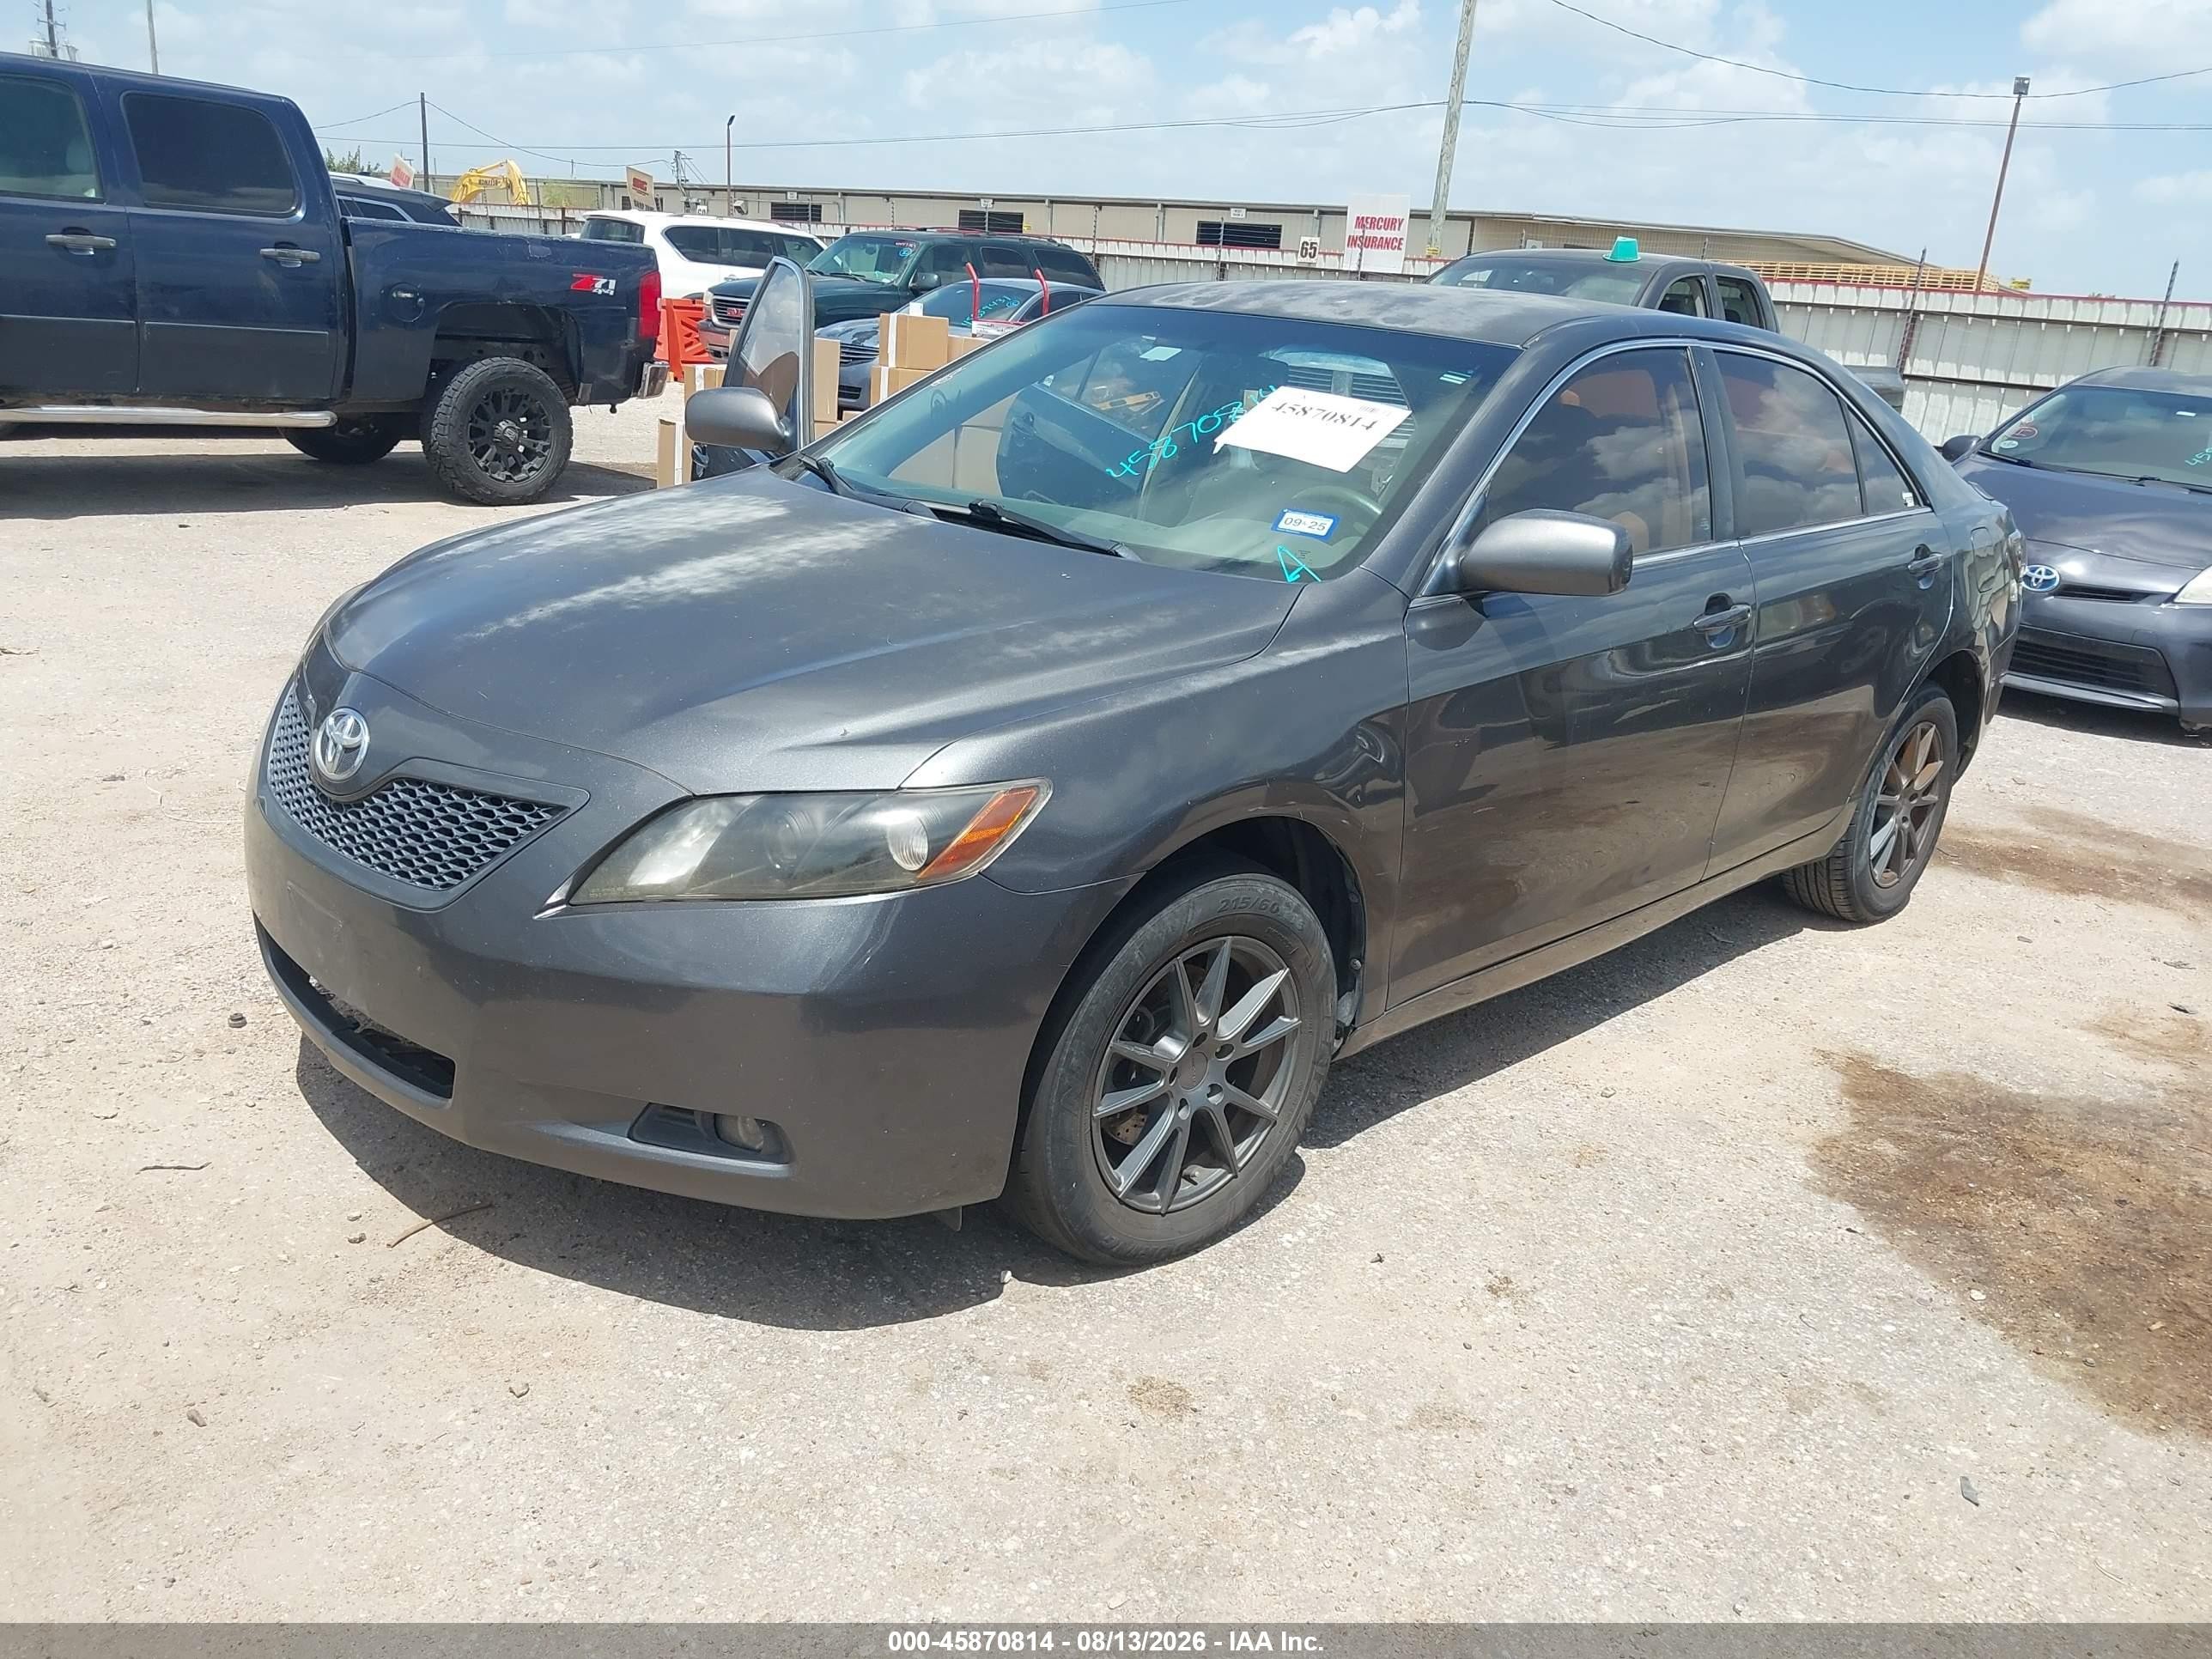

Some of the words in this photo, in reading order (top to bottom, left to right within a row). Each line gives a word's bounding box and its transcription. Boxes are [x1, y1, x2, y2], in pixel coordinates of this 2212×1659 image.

[1354, 216, 1405, 232] MERCURY
[1300, 240, 1318, 259] 65
[1346, 234, 1405, 252] INSURANCE
[570, 273, 617, 291] Z71
[1271, 401, 1380, 431] 45870814
[1284, 517, 1303, 527] 09
[1307, 520, 1327, 532] 25
